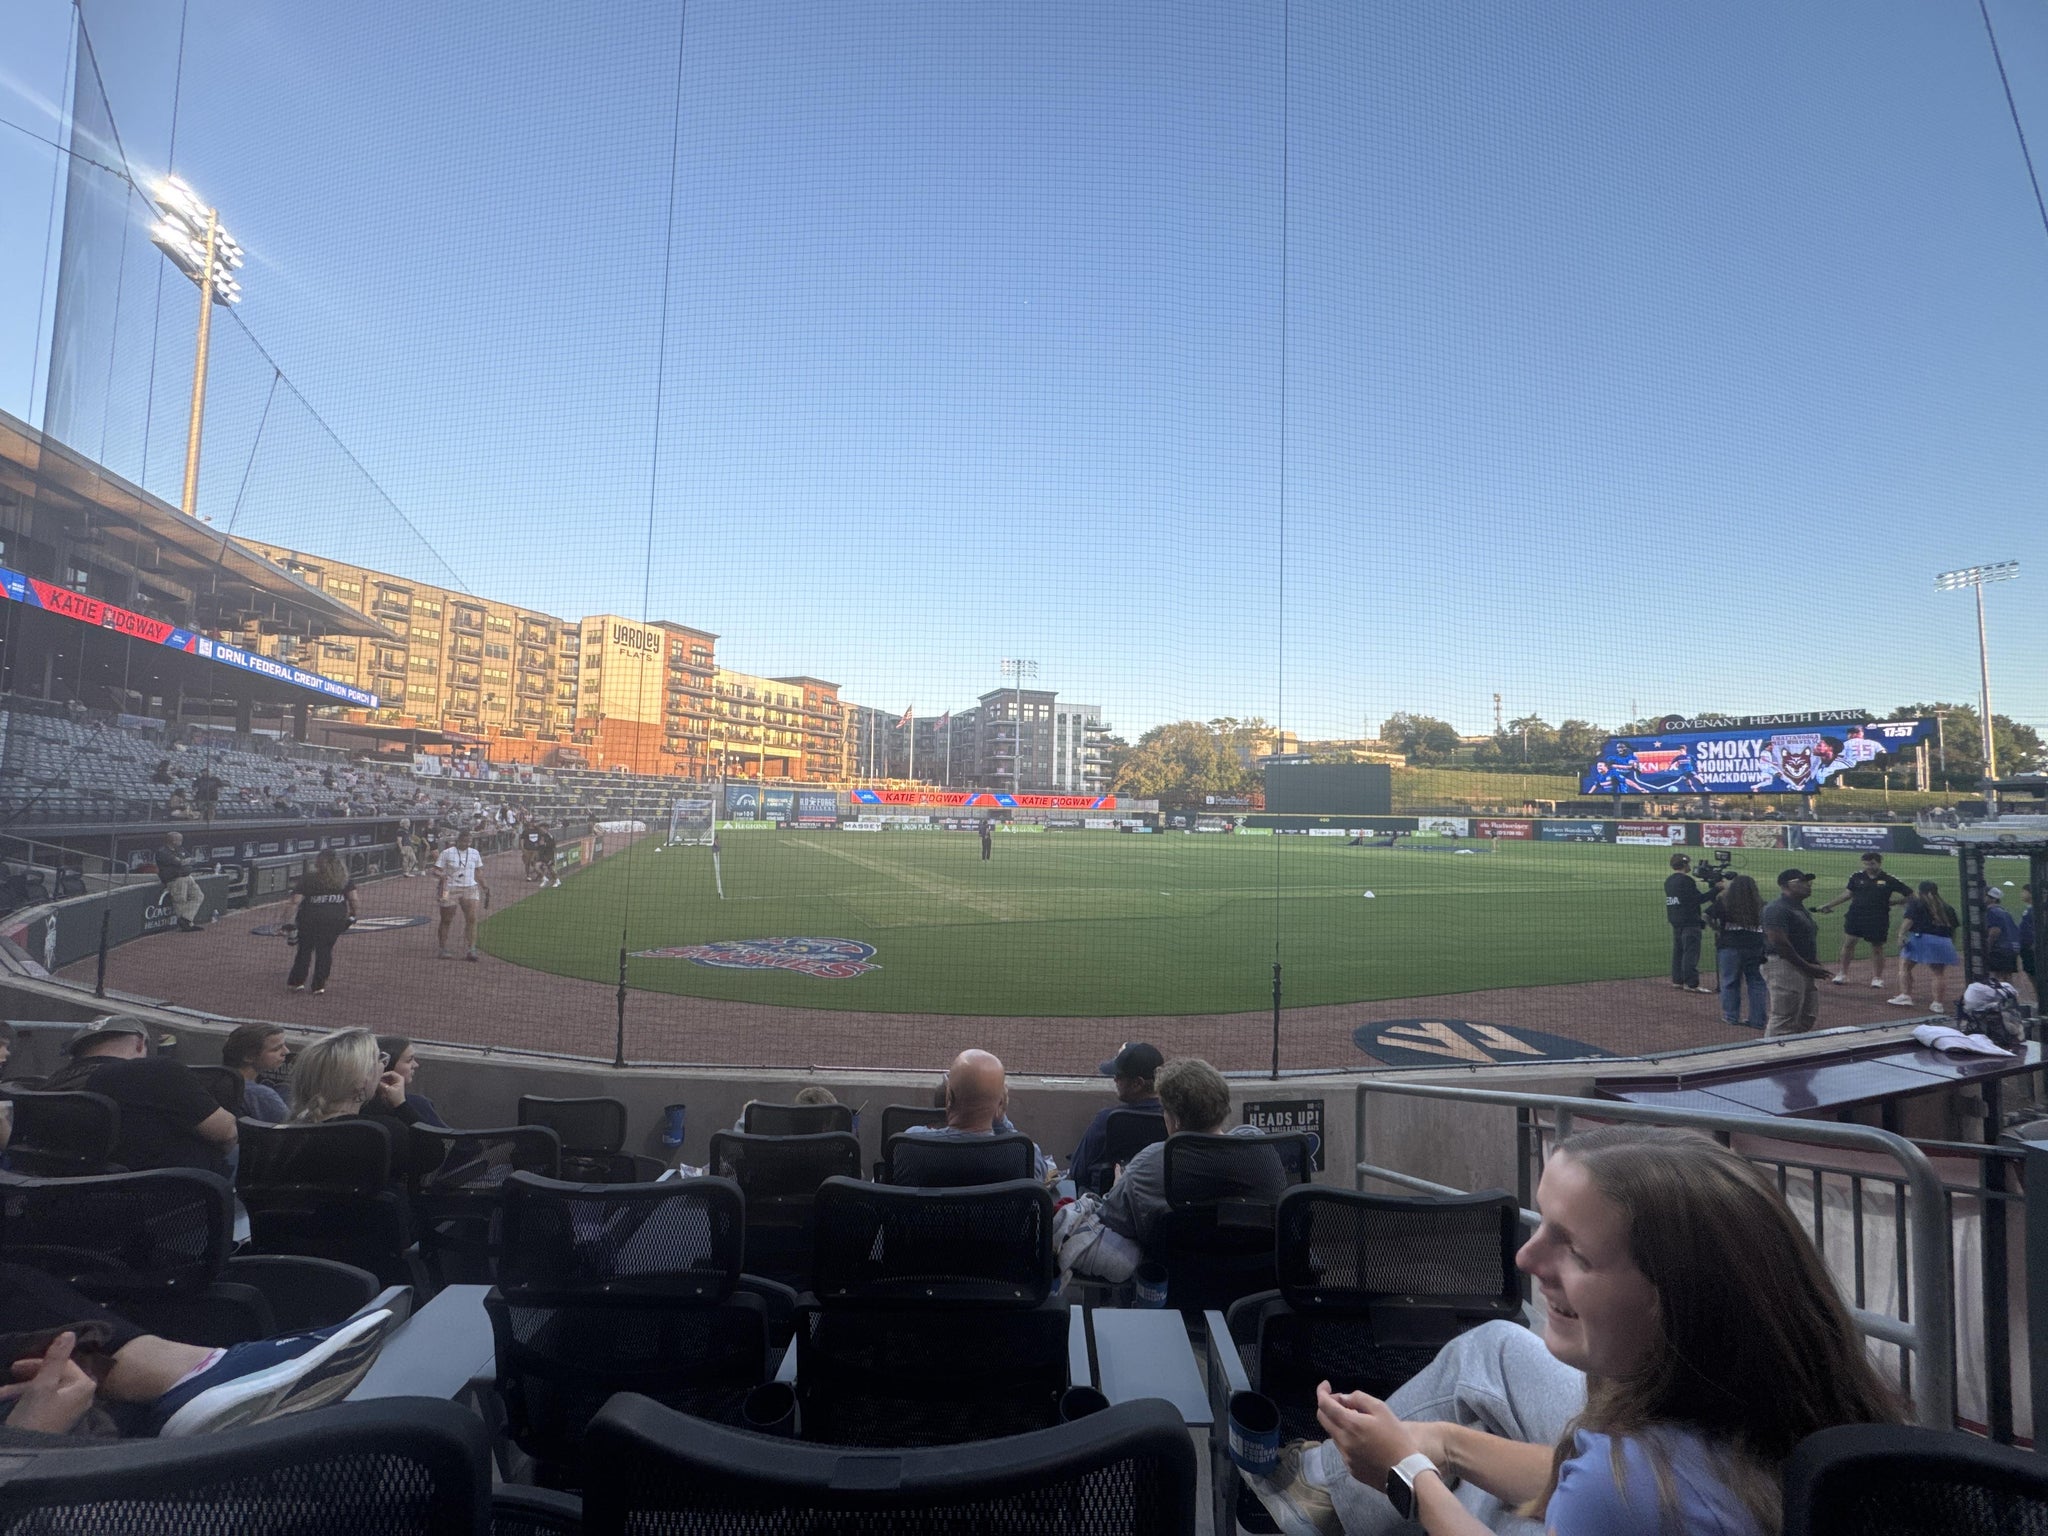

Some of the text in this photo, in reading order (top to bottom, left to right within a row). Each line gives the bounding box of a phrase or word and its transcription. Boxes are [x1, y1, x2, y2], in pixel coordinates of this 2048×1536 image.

[50, 590, 97, 618] KATIE
[620, 648, 653, 662] FLATS
[216, 646, 370, 704] ORNL FEDERAL CREDIT UNION PORCH
[1665, 708, 1864, 730] COVENANT HEALTH PARK
[1883, 726, 1912, 738] 17:57
[1696, 739, 1764, 760] SMOKY
[1696, 758, 1762, 773] MOUNTAIN
[1699, 772, 1764, 784] SMACKDOWN
[885, 793, 916, 802] KATIE
[1022, 796, 1048, 806] KATIE
[735, 822, 768, 830] REGIONS
[1490, 821, 1528, 830] Budweiser
[1703, 834, 1737, 846] Casey's
[1250, 1110, 1320, 1127] HEADS UP!
